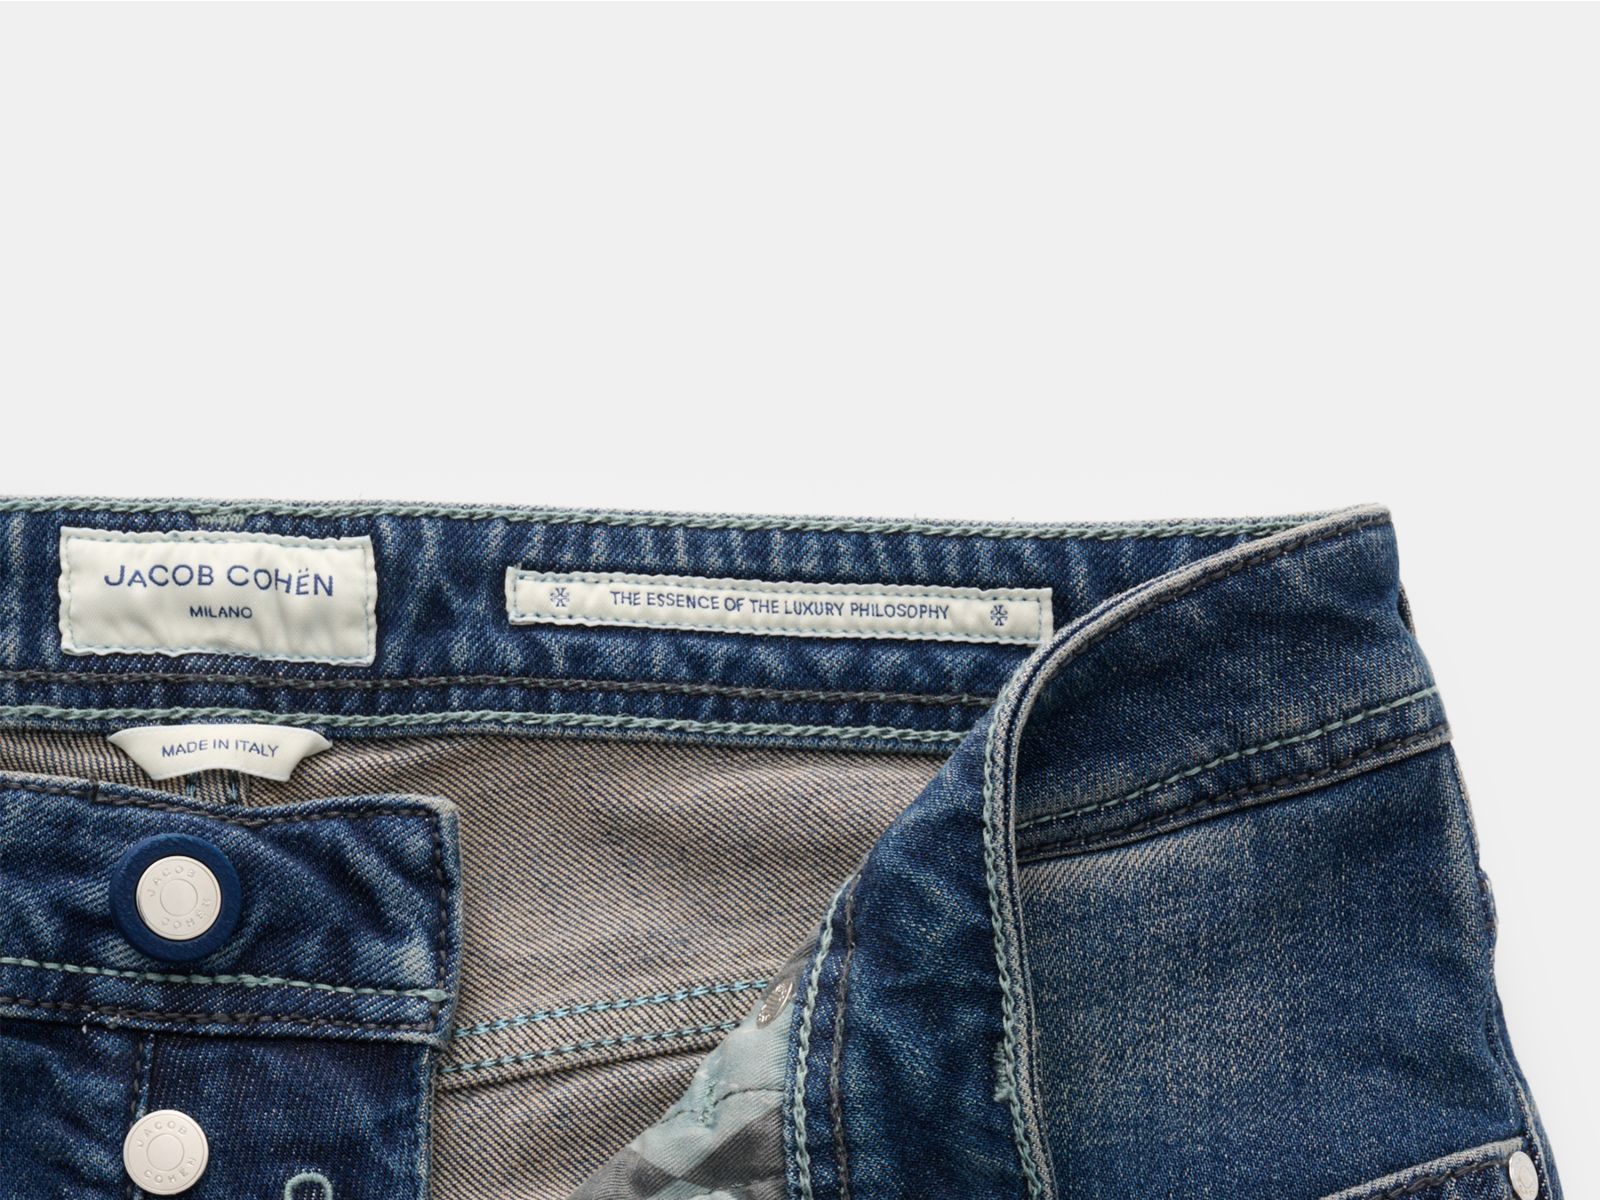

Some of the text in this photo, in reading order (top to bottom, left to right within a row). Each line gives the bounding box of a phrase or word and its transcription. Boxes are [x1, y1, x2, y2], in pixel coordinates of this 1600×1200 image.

[104, 564, 214, 588] JACOB
[189, 606, 253, 619] MILANO
[610, 590, 949, 620] THE ESSENCE OF THE LUXURY PHILOSOPHY
[161, 738, 279, 758] MADE IN ITALY
[147, 865, 196, 897] JACOB
[136, 1121, 187, 1148] JACOB
